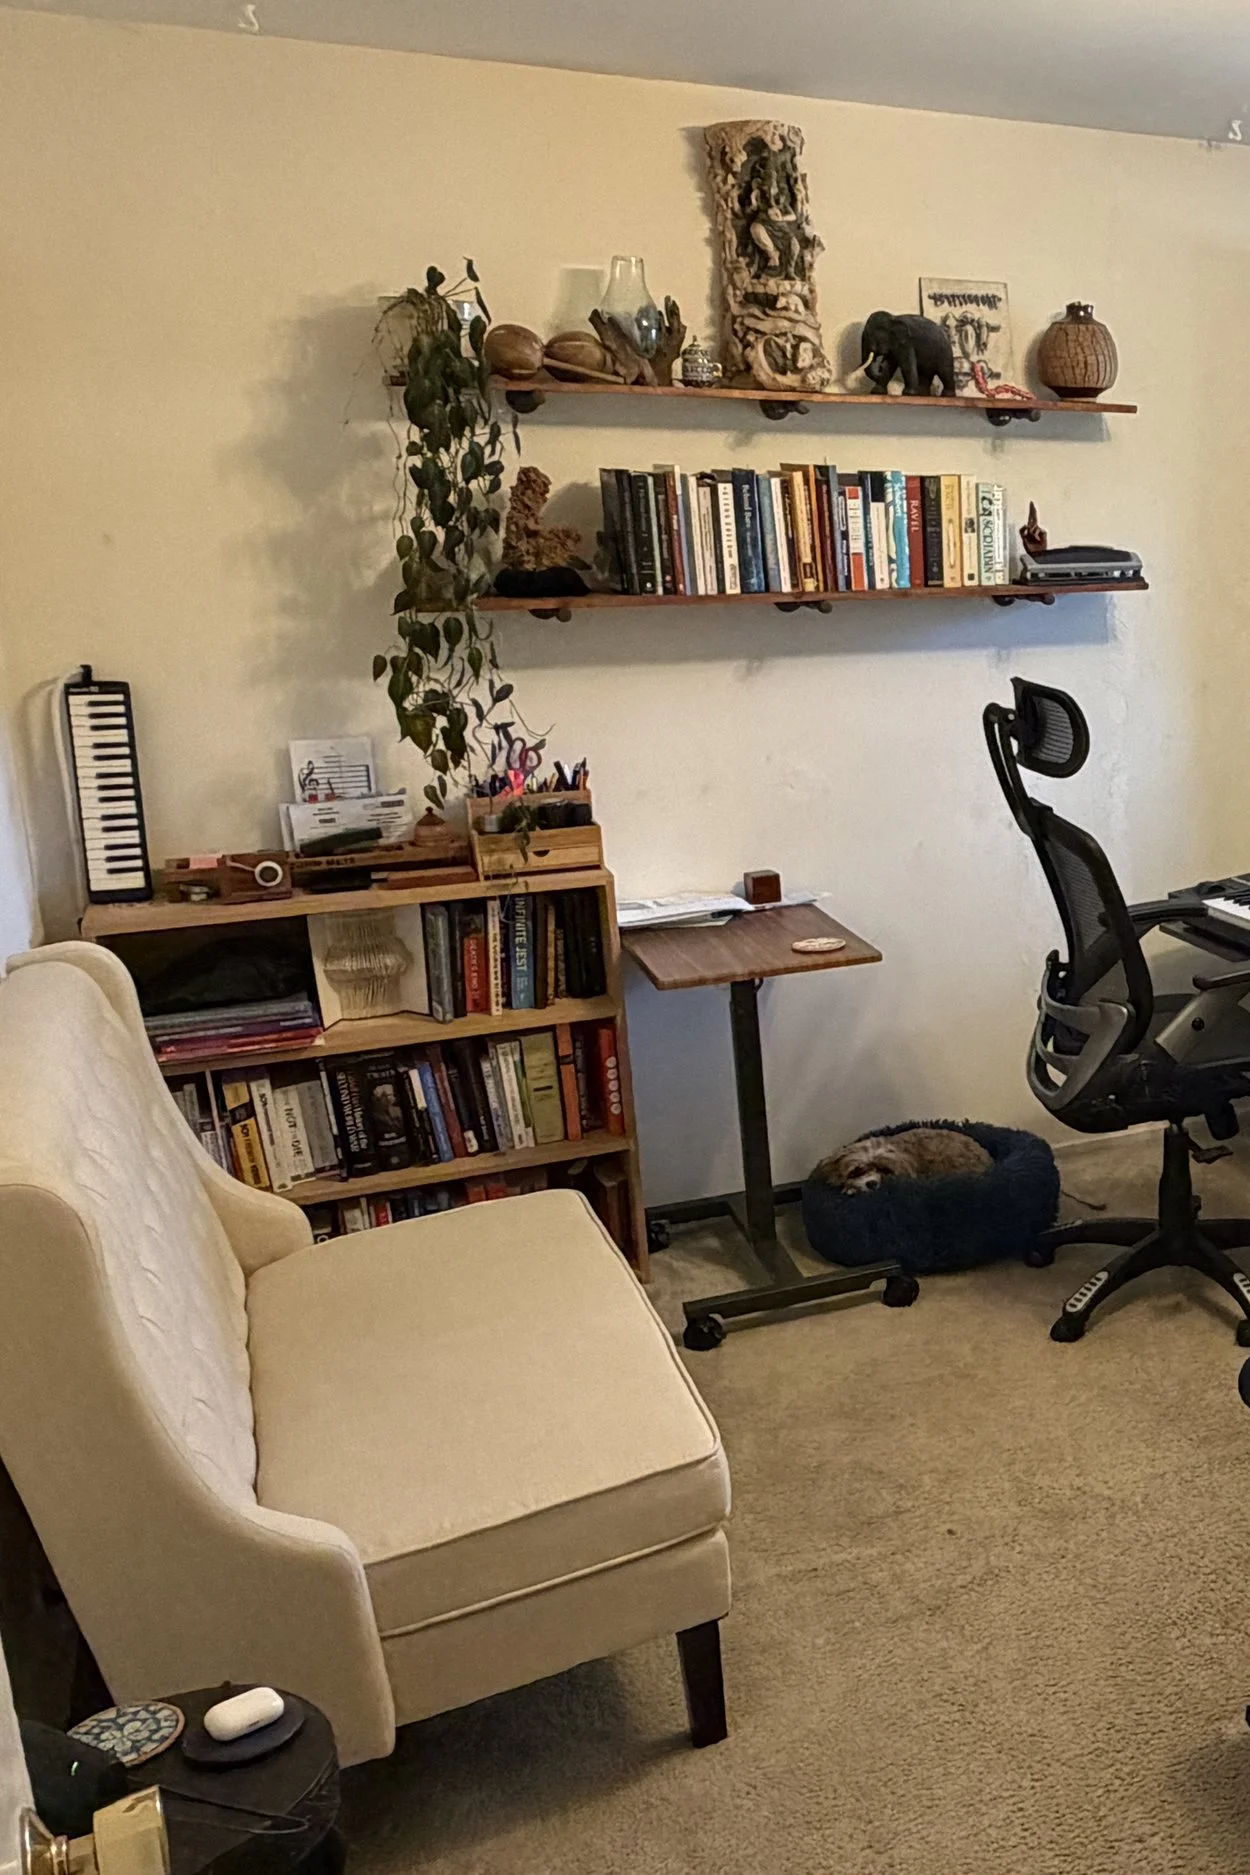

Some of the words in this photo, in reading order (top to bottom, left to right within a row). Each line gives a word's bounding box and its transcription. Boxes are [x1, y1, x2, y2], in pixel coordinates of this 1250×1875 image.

[910, 500, 919, 532] RAVEL
[982, 518, 993, 573] SCRIABIN
[515, 897, 526, 944] INFINITE
[516, 947, 528, 971] JEST
[284, 1107, 297, 1128] NOT
[291, 1139, 303, 1156] DIE
